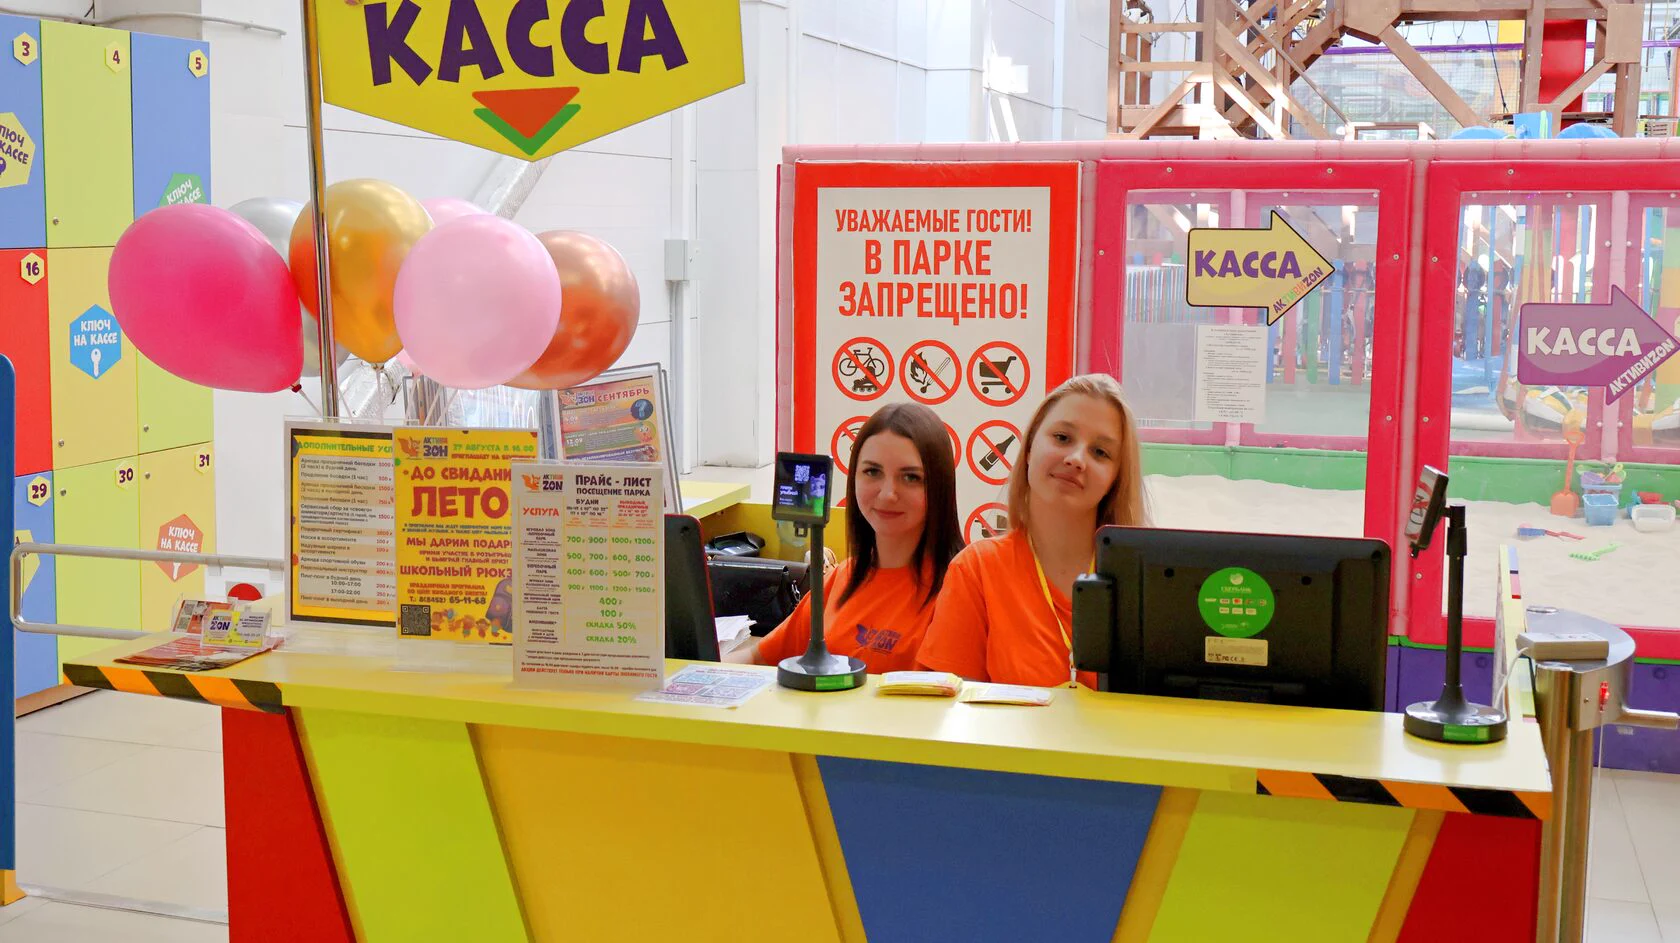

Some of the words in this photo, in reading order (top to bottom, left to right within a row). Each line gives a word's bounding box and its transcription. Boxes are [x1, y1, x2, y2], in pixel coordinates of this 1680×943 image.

[22, 42, 30, 56] 3
[364, 0, 689, 86] КАССА
[112, 50, 120, 64] 4
[195, 57, 202, 70] 5
[167, 179, 192, 205] КЛЮЧ
[836, 209, 959, 232] УВАЖАЕМЫЕ
[966, 209, 1032, 232] ГОСТИ!
[865, 240, 882, 274] В
[894, 240, 992, 275] ПАРКЕ
[1195, 250, 1302, 279] КАССА
[26, 262, 40, 276] 16
[838, 282, 1028, 326] ЗАПРЕЩЕНО!
[81, 320, 111, 332] КЛЮЧ
[74, 334, 87, 346] НА
[91, 332, 117, 346] КАССЕ
[1527, 326, 1642, 357] КАССА
[1609, 338, 1675, 396] АКТИВИZON
[598, 388, 650, 402] СЕНТЯБРЬ
[298, 442, 374, 452] ДОПОЛНИТЕЛЬНЫЕ
[424, 446, 448, 458] ЗОН
[200, 454, 210, 468] 31
[119, 468, 134, 482] 30
[411, 466, 436, 480] ДО
[576, 474, 612, 488] ПРАЙС
[624, 477, 652, 488] ЛИСТ
[32, 483, 47, 498] 29
[543, 480, 563, 491] ZON
[577, 488, 622, 498] ПОСЕЩЕНИЕ
[624, 489, 651, 497] ПАРКА
[412, 486, 508, 519] ЛЕТО
[523, 507, 560, 517] УСЛУГА
[168, 526, 195, 540] КЛЮЧ
[161, 537, 172, 550] НА
[175, 540, 198, 552] КАССЕ
[407, 538, 426, 546] МЫ
[430, 538, 470, 548] ДАРИМ
[400, 565, 472, 577] ШКОЛЬНЫЙ
[210, 622, 231, 630] ZON
[617, 622, 636, 630] 50%
[617, 636, 637, 644] 20%
